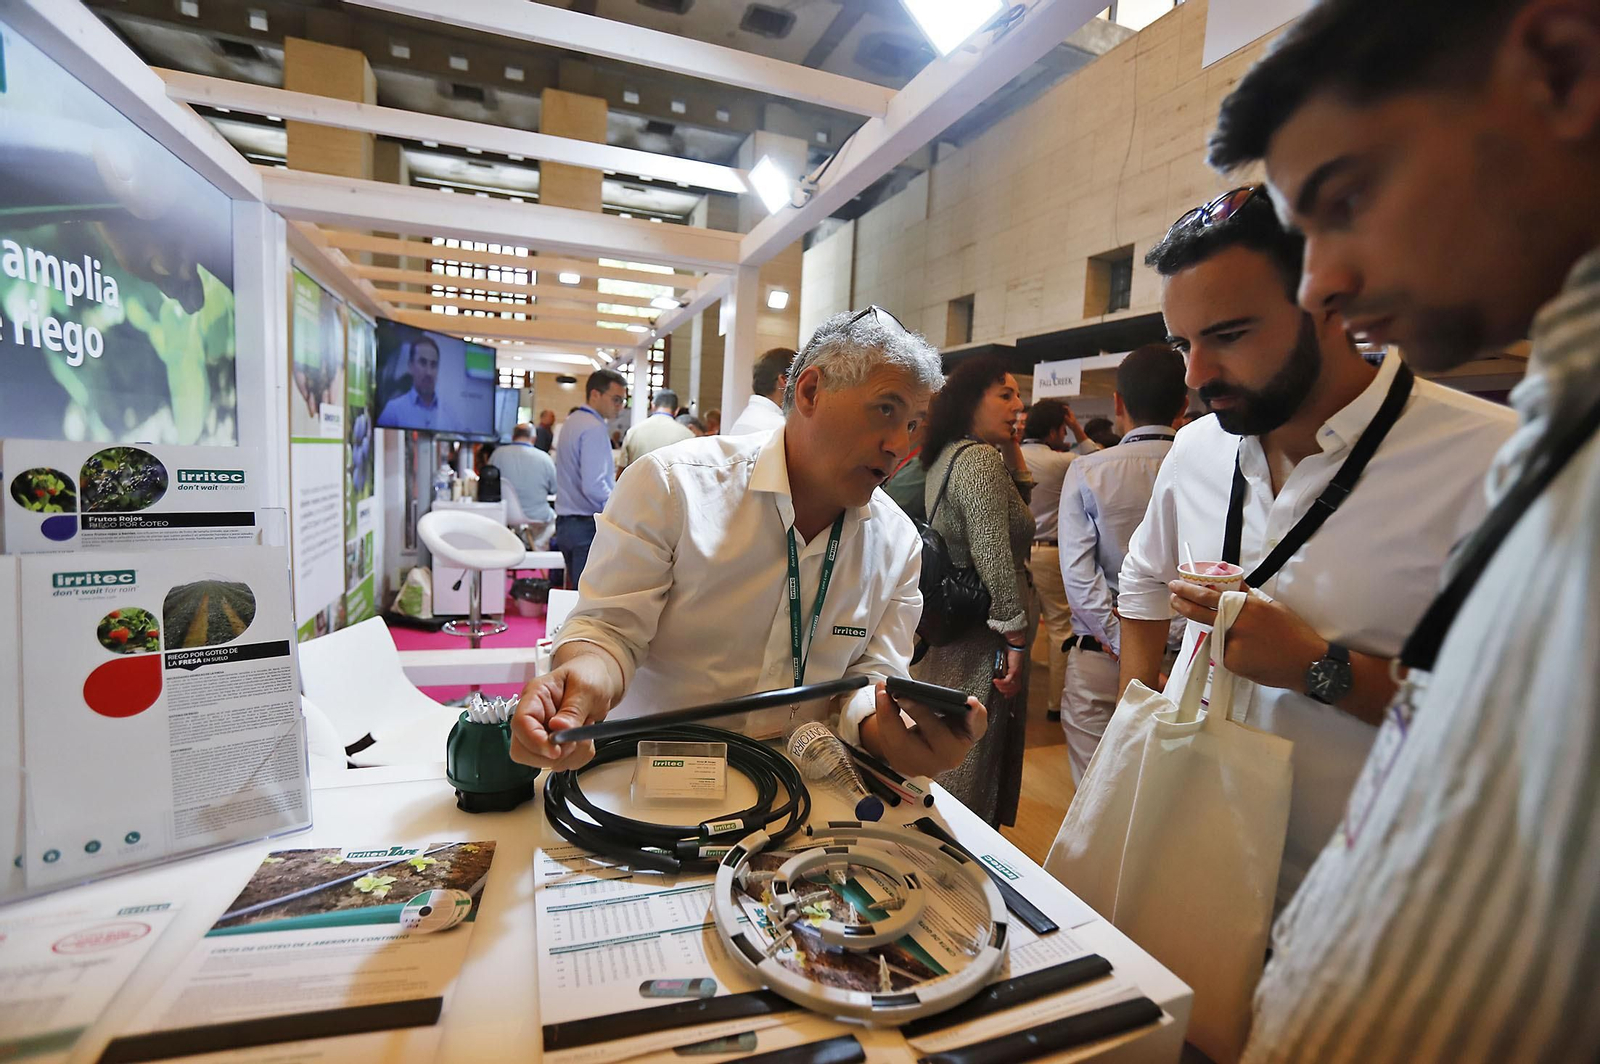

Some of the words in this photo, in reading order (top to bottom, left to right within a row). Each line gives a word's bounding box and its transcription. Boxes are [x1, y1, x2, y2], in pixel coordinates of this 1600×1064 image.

[2, 239, 120, 308] amplia
[13, 299, 104, 367] riego
[180, 470, 243, 482] irritec
[118, 515, 143, 523] Rojos
[57, 573, 133, 586] irritec
[52, 589, 79, 597] don't
[81, 587, 103, 595] wait
[119, 585, 136, 593] rain
[834, 626, 866, 637] irritec
[167, 651, 189, 661] RIEGO
[190, 650, 205, 658] POR
[205, 649, 228, 657] GOTEO
[178, 658, 202, 666] FRESA
[980, 854, 1020, 880] irritec
[307, 937, 360, 947] LABERINTO
[361, 933, 410, 942] CONTINUO
